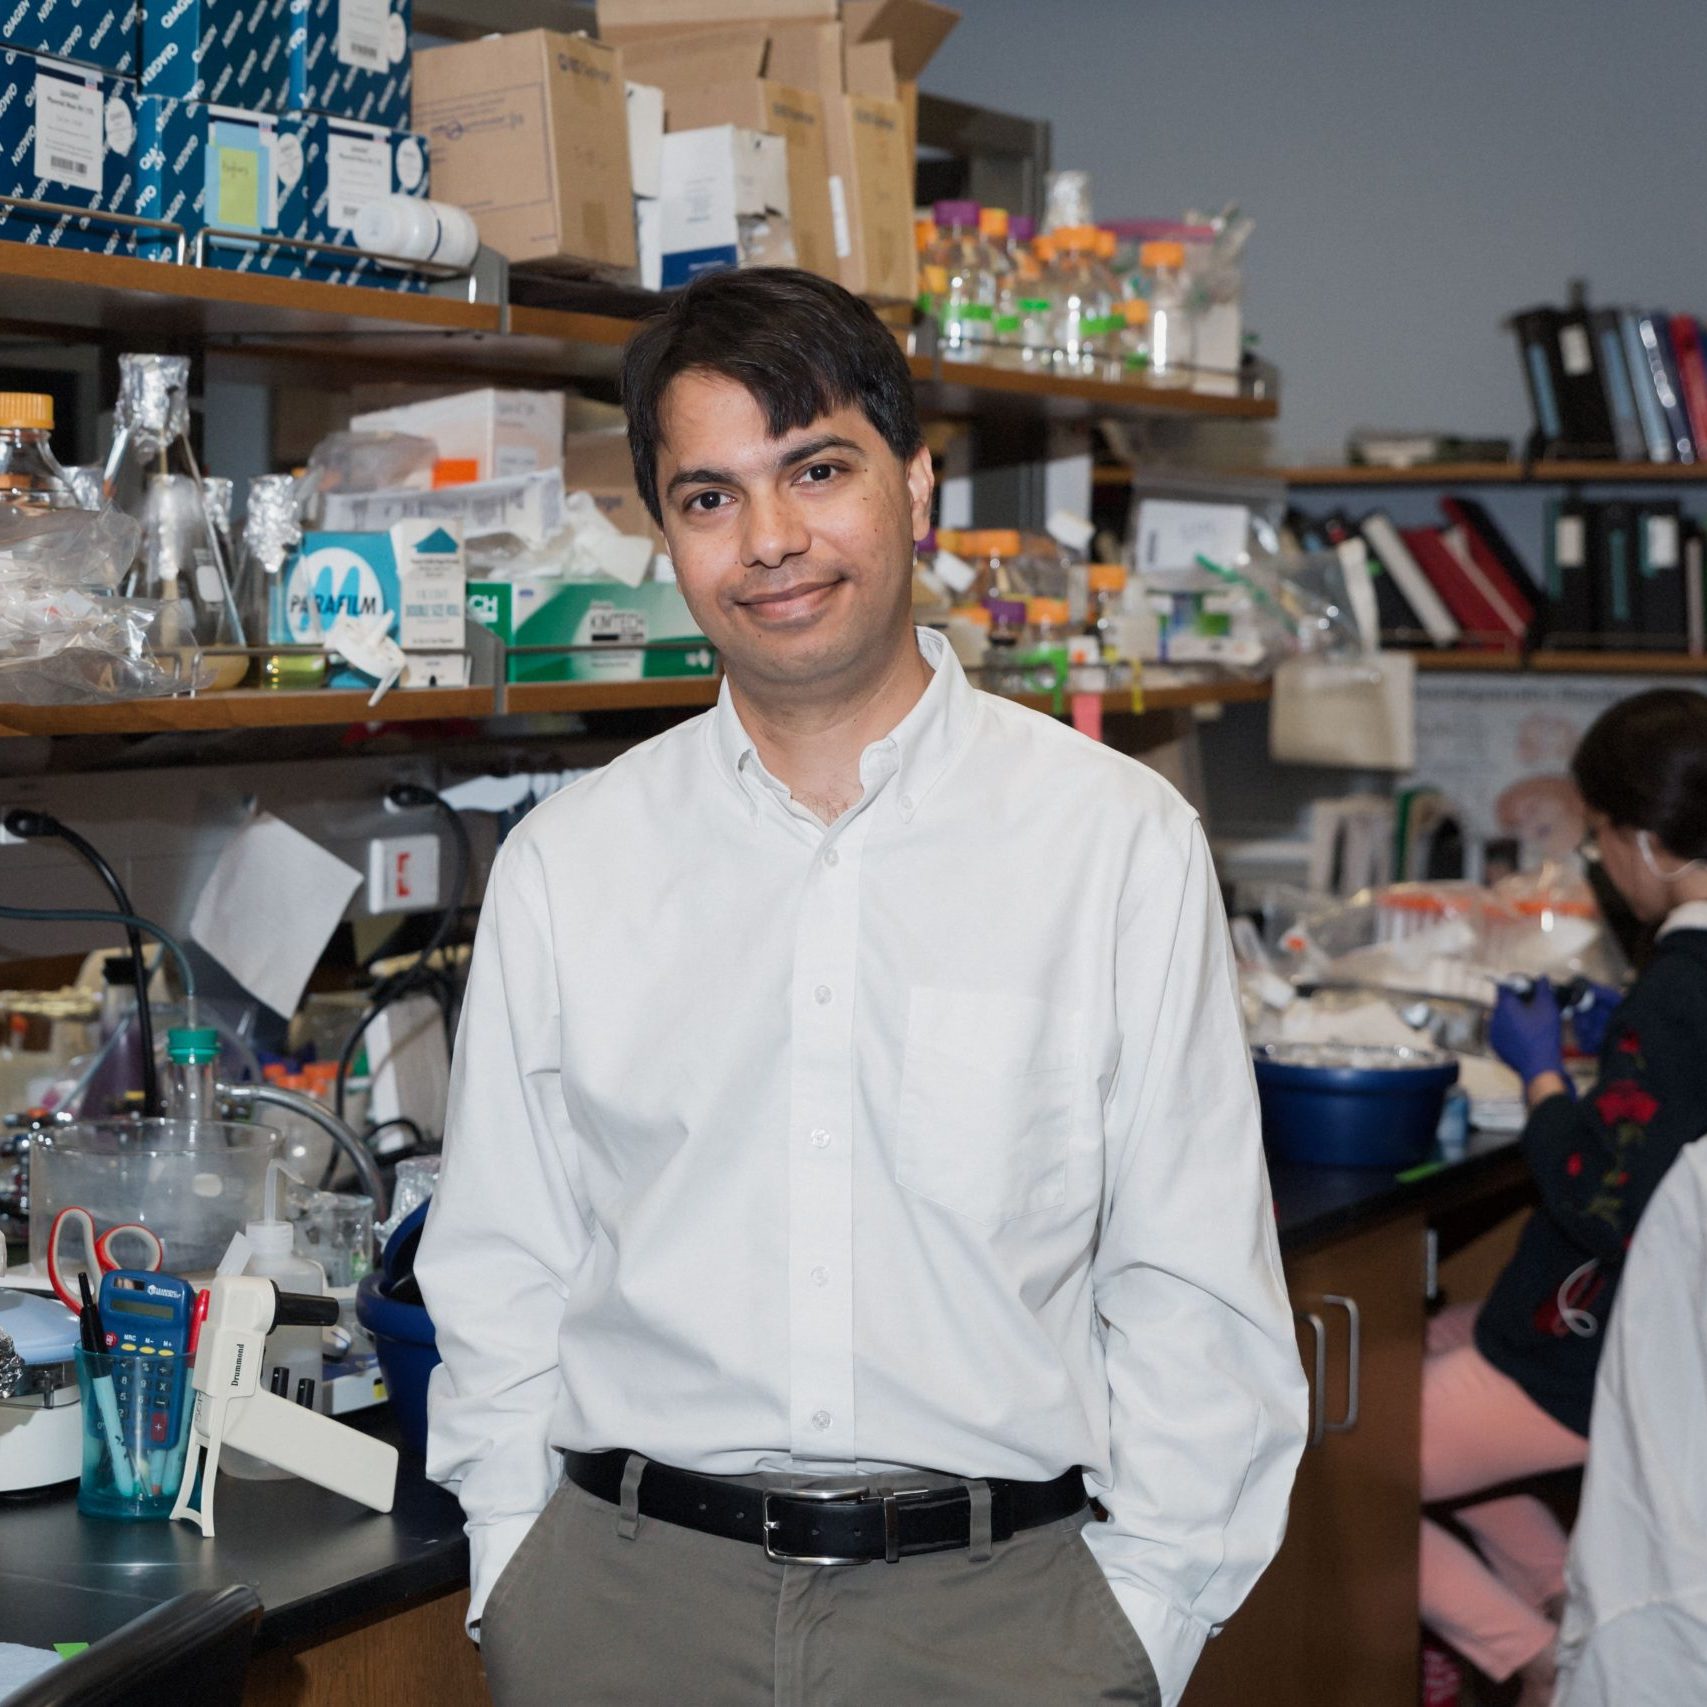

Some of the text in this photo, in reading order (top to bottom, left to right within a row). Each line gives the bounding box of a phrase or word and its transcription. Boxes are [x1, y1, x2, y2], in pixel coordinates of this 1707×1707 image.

[141, 42, 179, 87] QIAGEN
[289, 593, 377, 617] PARAFILM
[230, 1343, 245, 1387] Drummond
